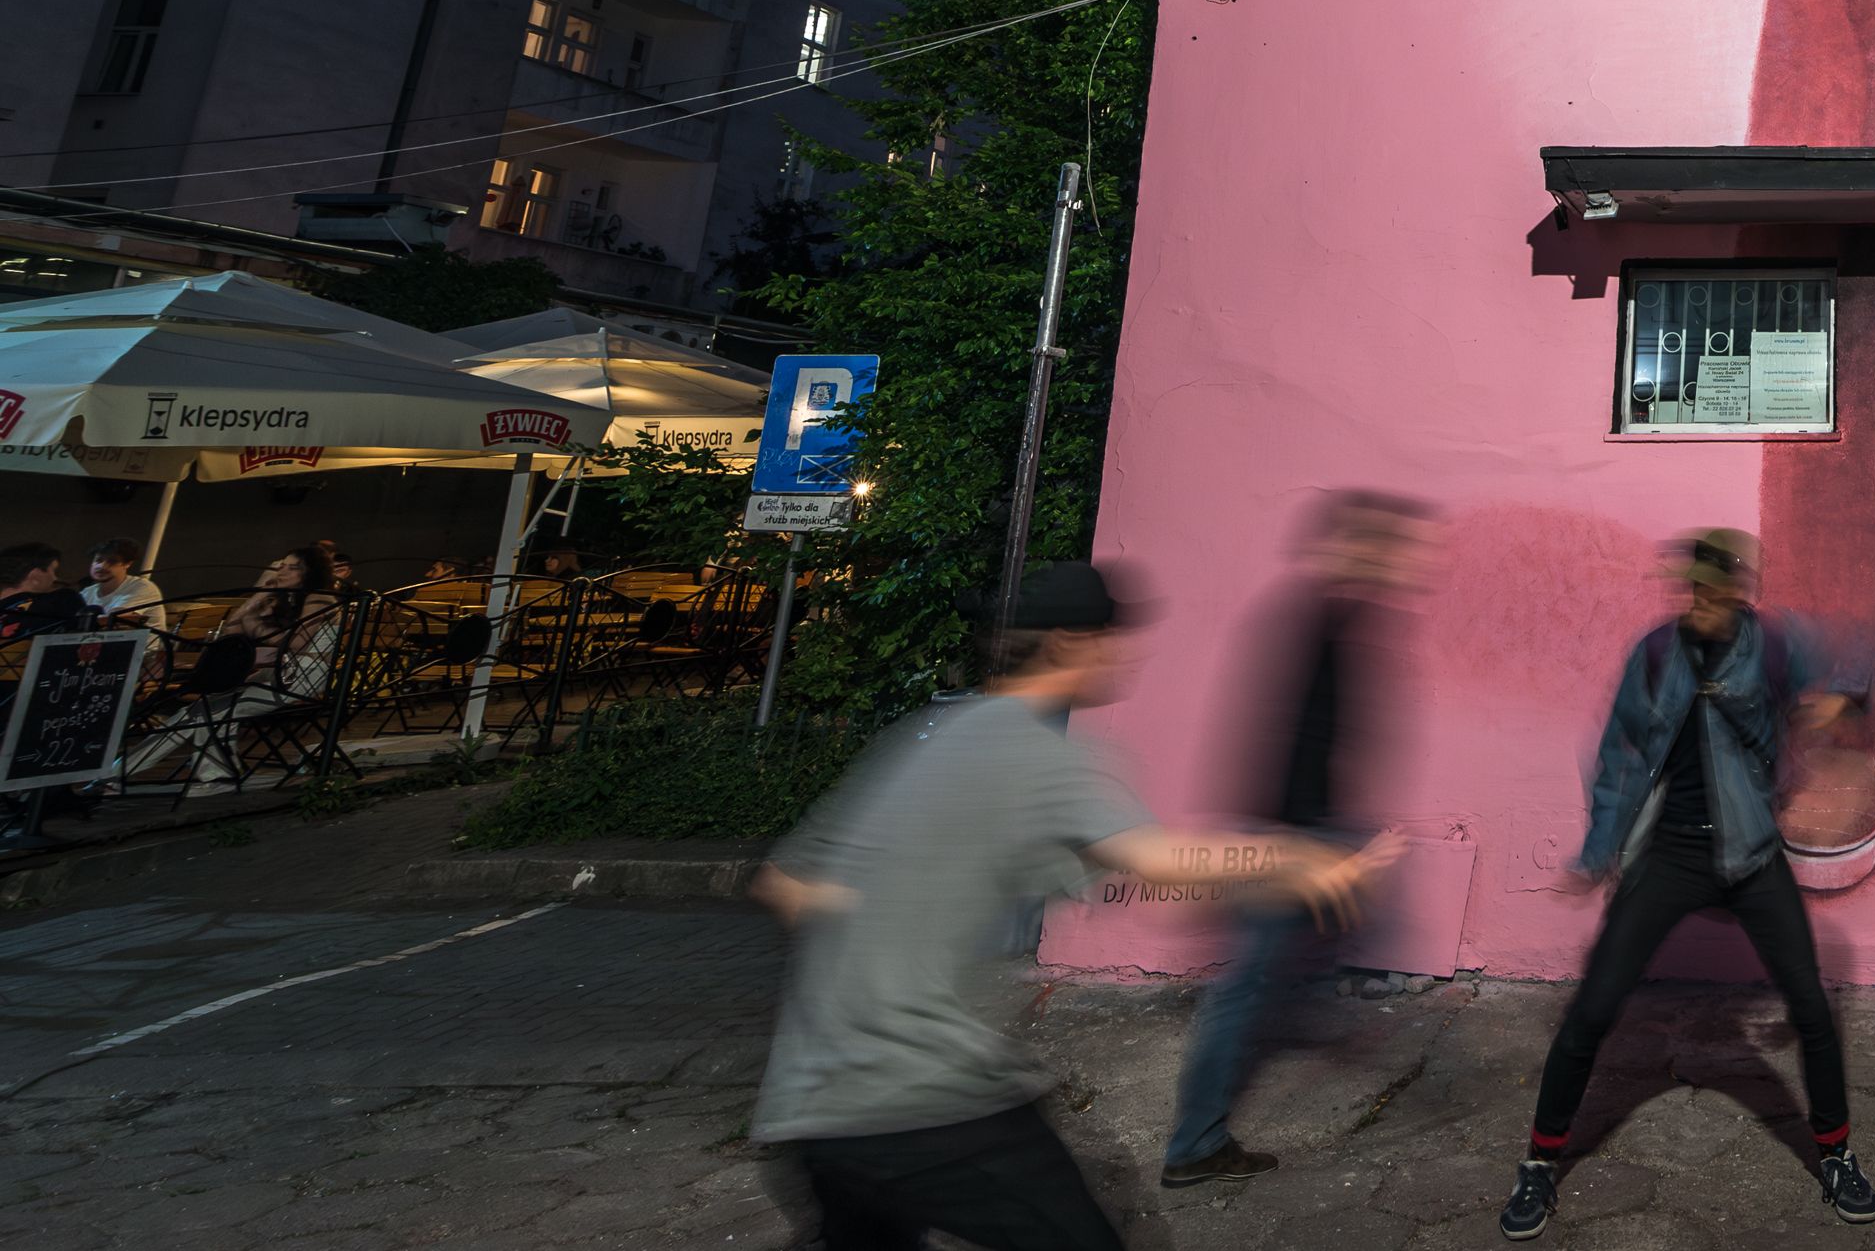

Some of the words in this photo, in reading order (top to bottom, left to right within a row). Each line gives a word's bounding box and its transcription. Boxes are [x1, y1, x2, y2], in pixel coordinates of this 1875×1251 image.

[180, 405, 309, 431] klepsydra
[785, 367, 854, 451] P
[494, 412, 563, 438] ŻYWIEC
[764, 514, 788, 524] służb
[790, 515, 831, 527] miejskich
[781, 502, 802, 514] Tylko
[804, 502, 819, 512] dla
[1103, 881, 1202, 908] DJ/MUSIC
